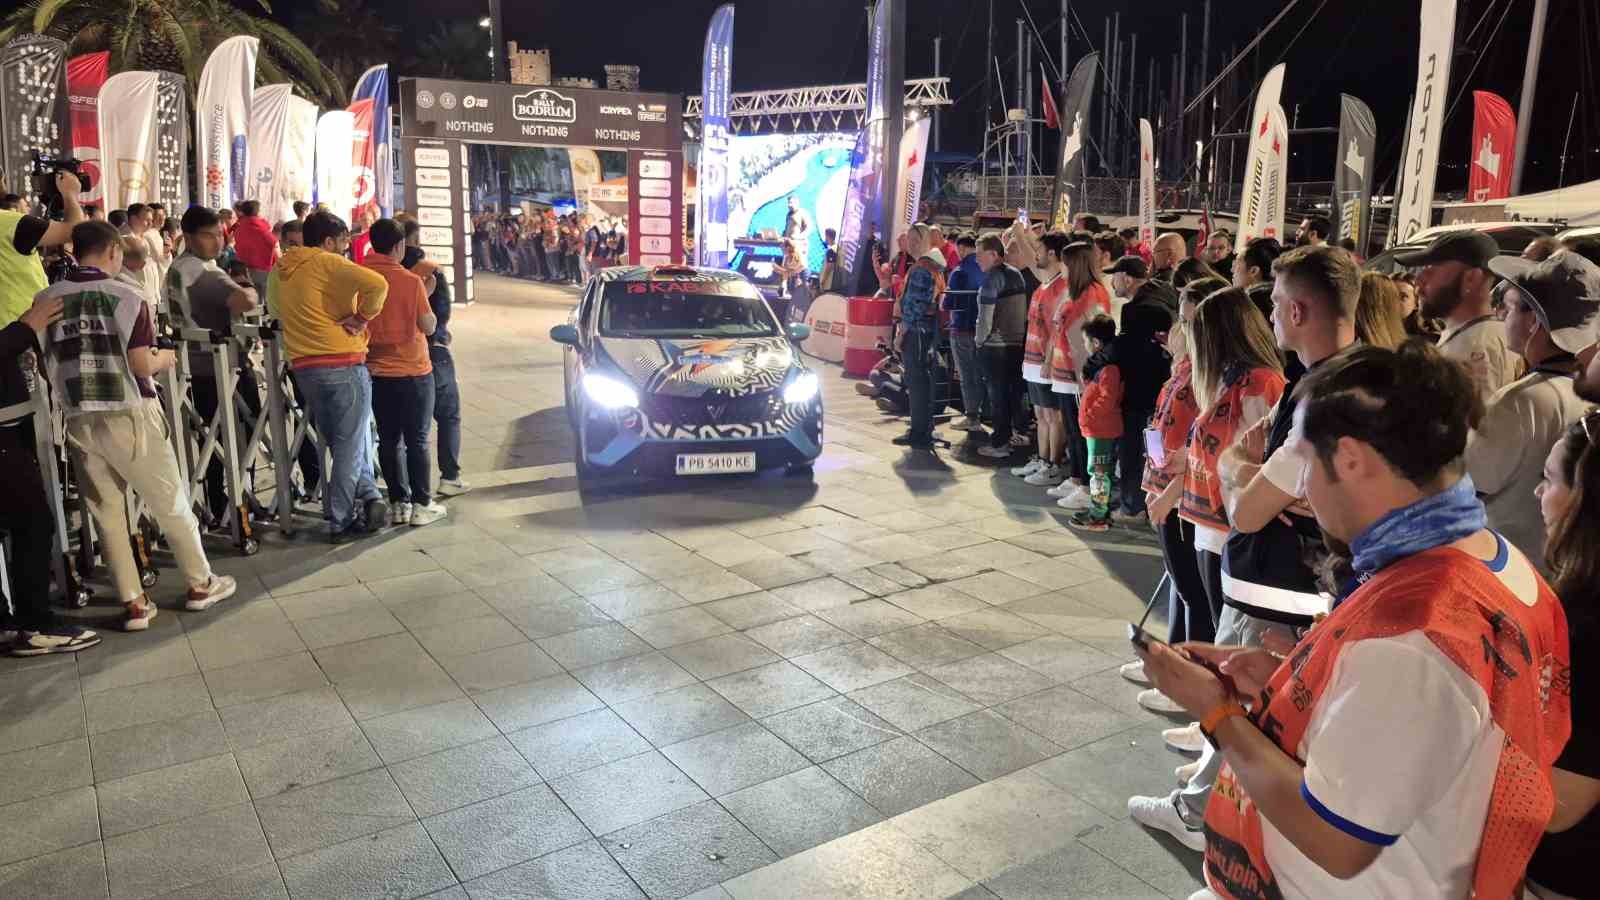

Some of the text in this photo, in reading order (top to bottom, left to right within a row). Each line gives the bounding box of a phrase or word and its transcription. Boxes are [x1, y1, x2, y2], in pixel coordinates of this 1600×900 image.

[518, 104, 571, 118] BODRUM
[446, 120, 494, 134] NOTHING
[521, 124, 569, 138] NOTHING
[594, 128, 641, 141] NOTHING
[707, 455, 733, 469] 5410
[735, 454, 753, 468] KE
